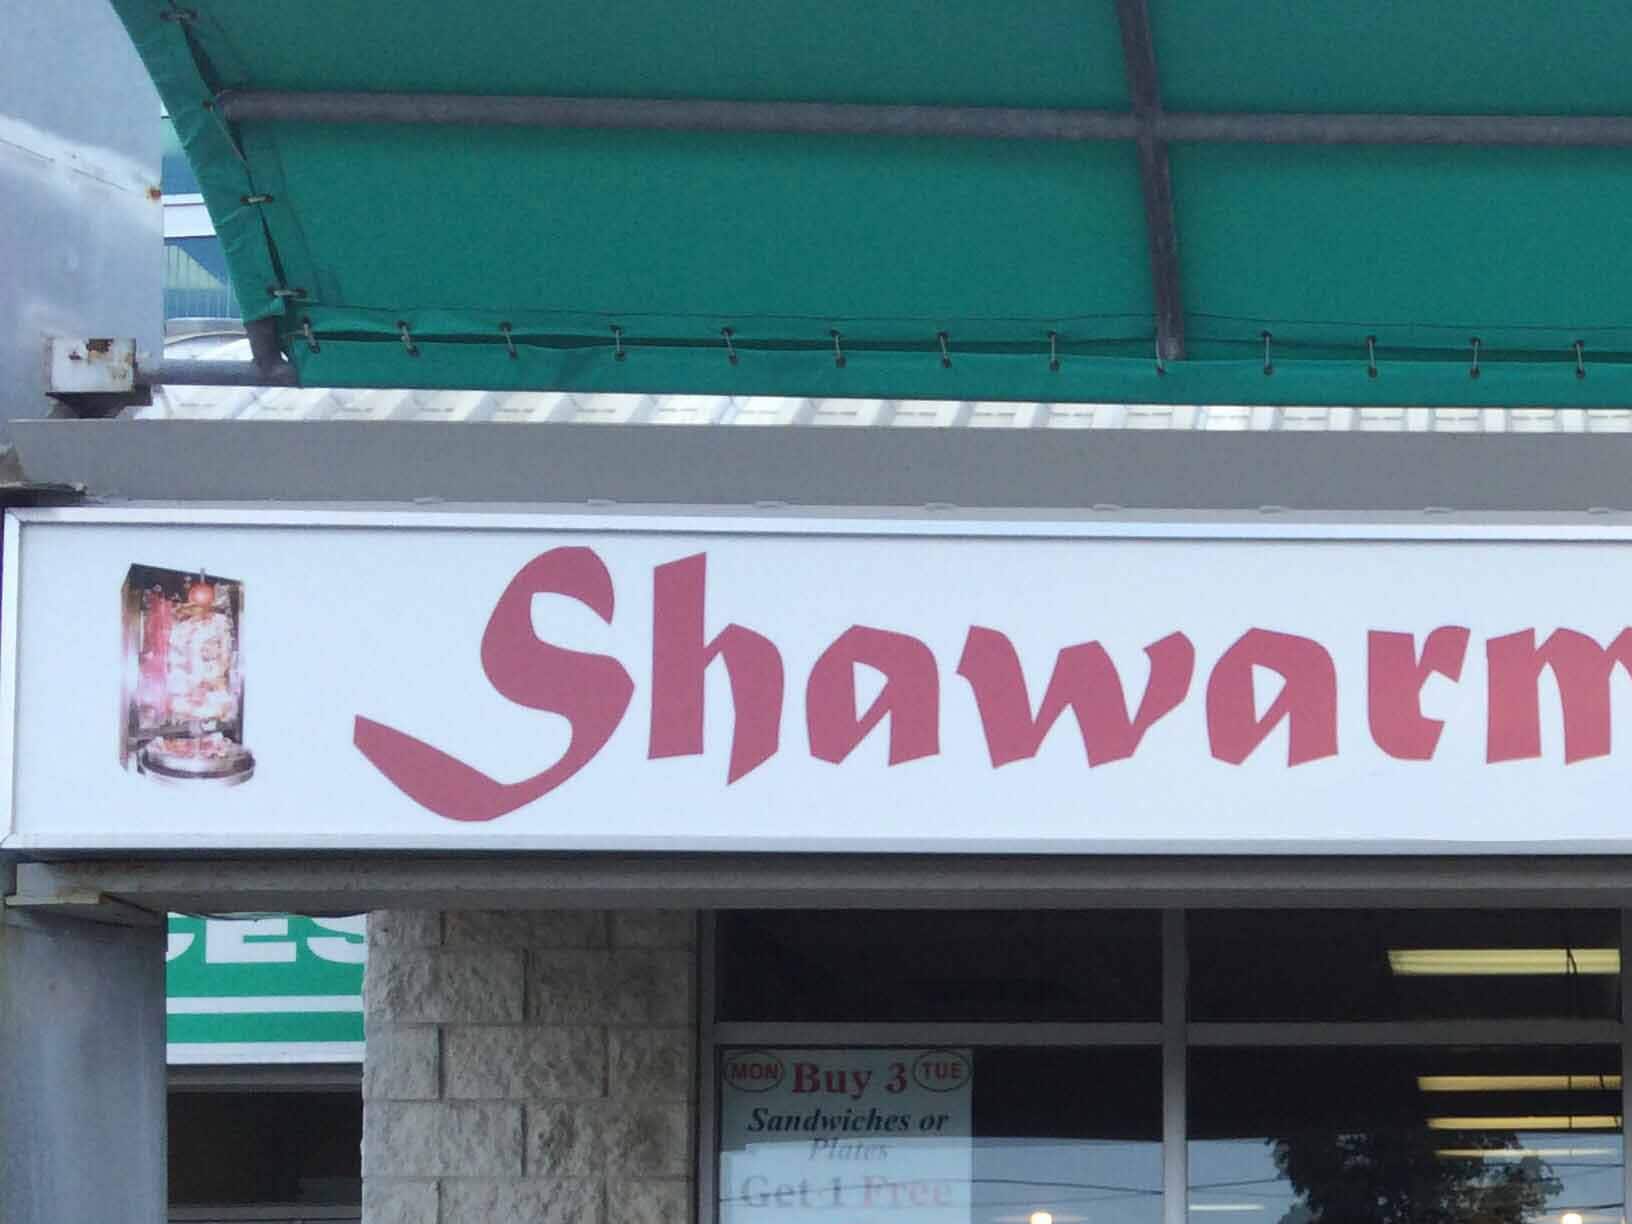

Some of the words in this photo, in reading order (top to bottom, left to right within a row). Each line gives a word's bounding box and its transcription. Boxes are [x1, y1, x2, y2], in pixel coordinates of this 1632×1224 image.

[732, 1063, 779, 1080] MON
[792, 1062, 872, 1099] Buy
[885, 1062, 907, 1093] 3
[922, 1062, 961, 1079] TUE
[747, 1108, 911, 1131] Sandwiches
[919, 1114, 949, 1131] or
[808, 1138, 888, 1160] Plates
[742, 1175, 809, 1208] Get
[864, 1175, 953, 1208] Free
